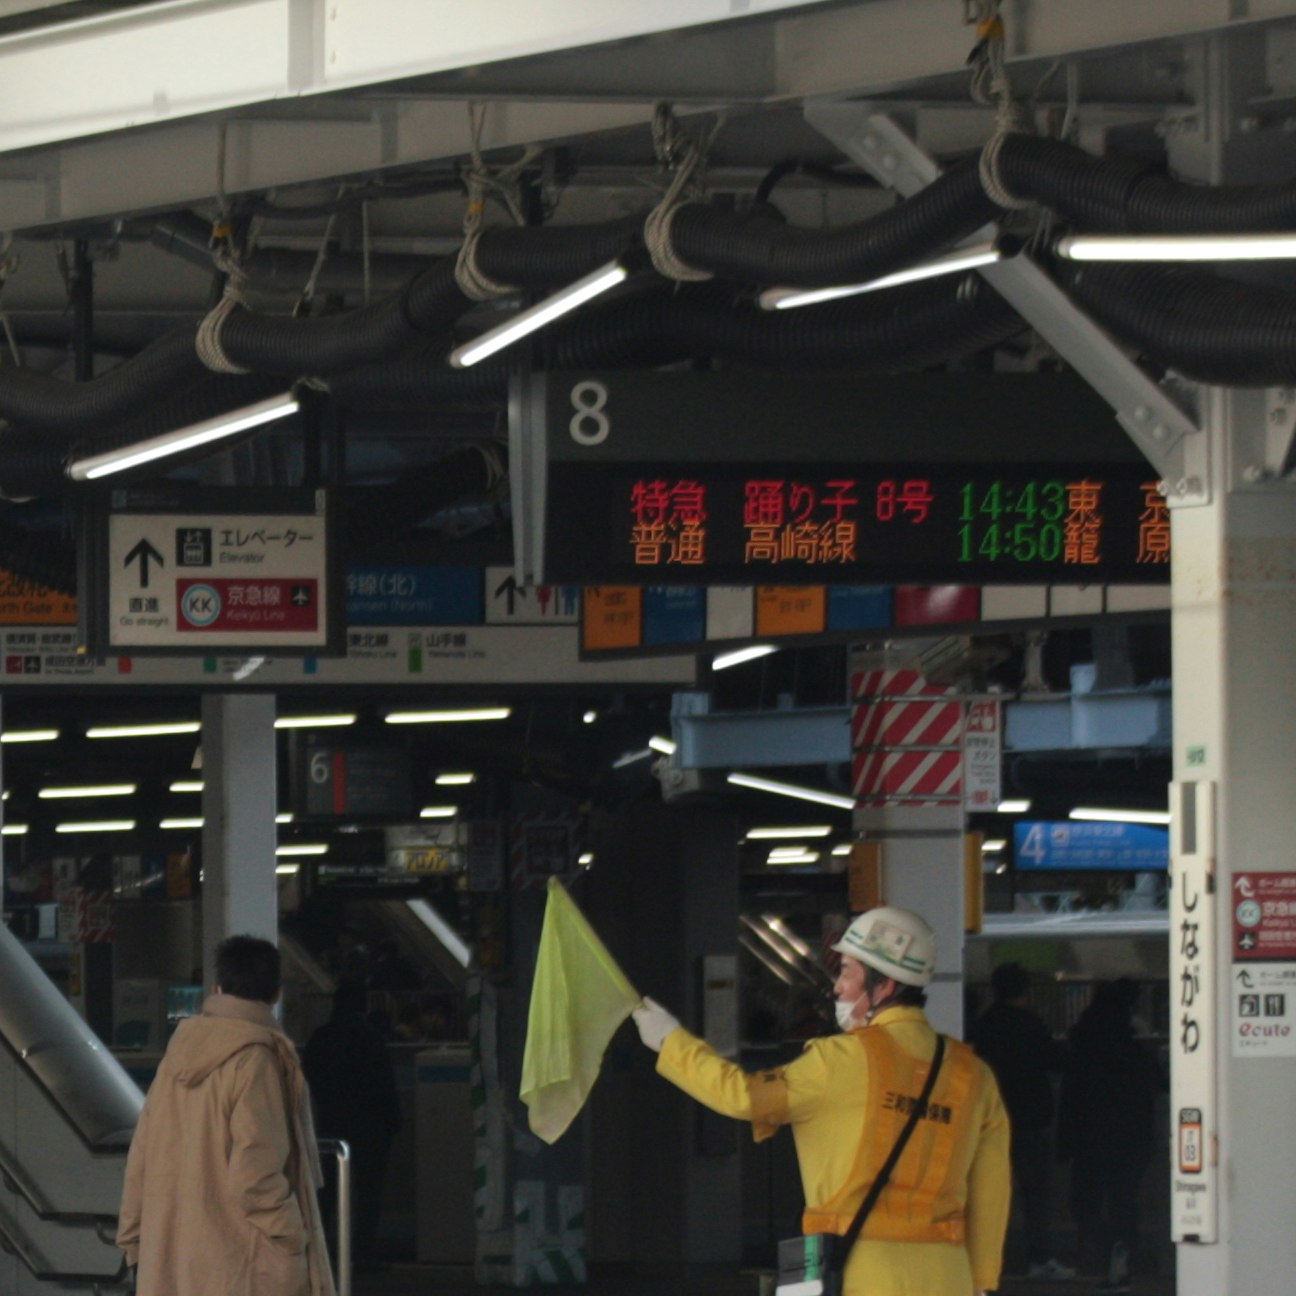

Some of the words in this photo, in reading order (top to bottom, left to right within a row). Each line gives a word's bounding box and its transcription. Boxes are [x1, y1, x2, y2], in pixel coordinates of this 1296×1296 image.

[569, 381, 610, 446] 8
[630, 480, 708, 523] 特急
[743, 480, 859, 523] 踊り子
[875, 480, 934, 523] 8号
[958, 480, 1066, 521] 14:43
[219, 529, 313, 548] エレベーター
[629, 521, 706, 564] 普通
[743, 521, 857, 564] 高崎線
[957, 521, 1064, 562] 14:50
[219, 552, 265, 563] Elevator
[226, 584, 281, 606] 京急線
[24, 602, 52, 614] Gate
[129, 597, 159, 613] 直進
[188, 598, 213, 613] KK
[120, 617, 133, 626] Go
[137, 616, 168, 628] straight
[264, 609, 285, 621] Line
[426, 633, 467, 647] 山手線
[310, 751, 328, 784] 6
[1019, 821, 1046, 865] 4
[1181, 871, 1200, 1054] しながわ
[1239, 1023, 1291, 1037] ecute
